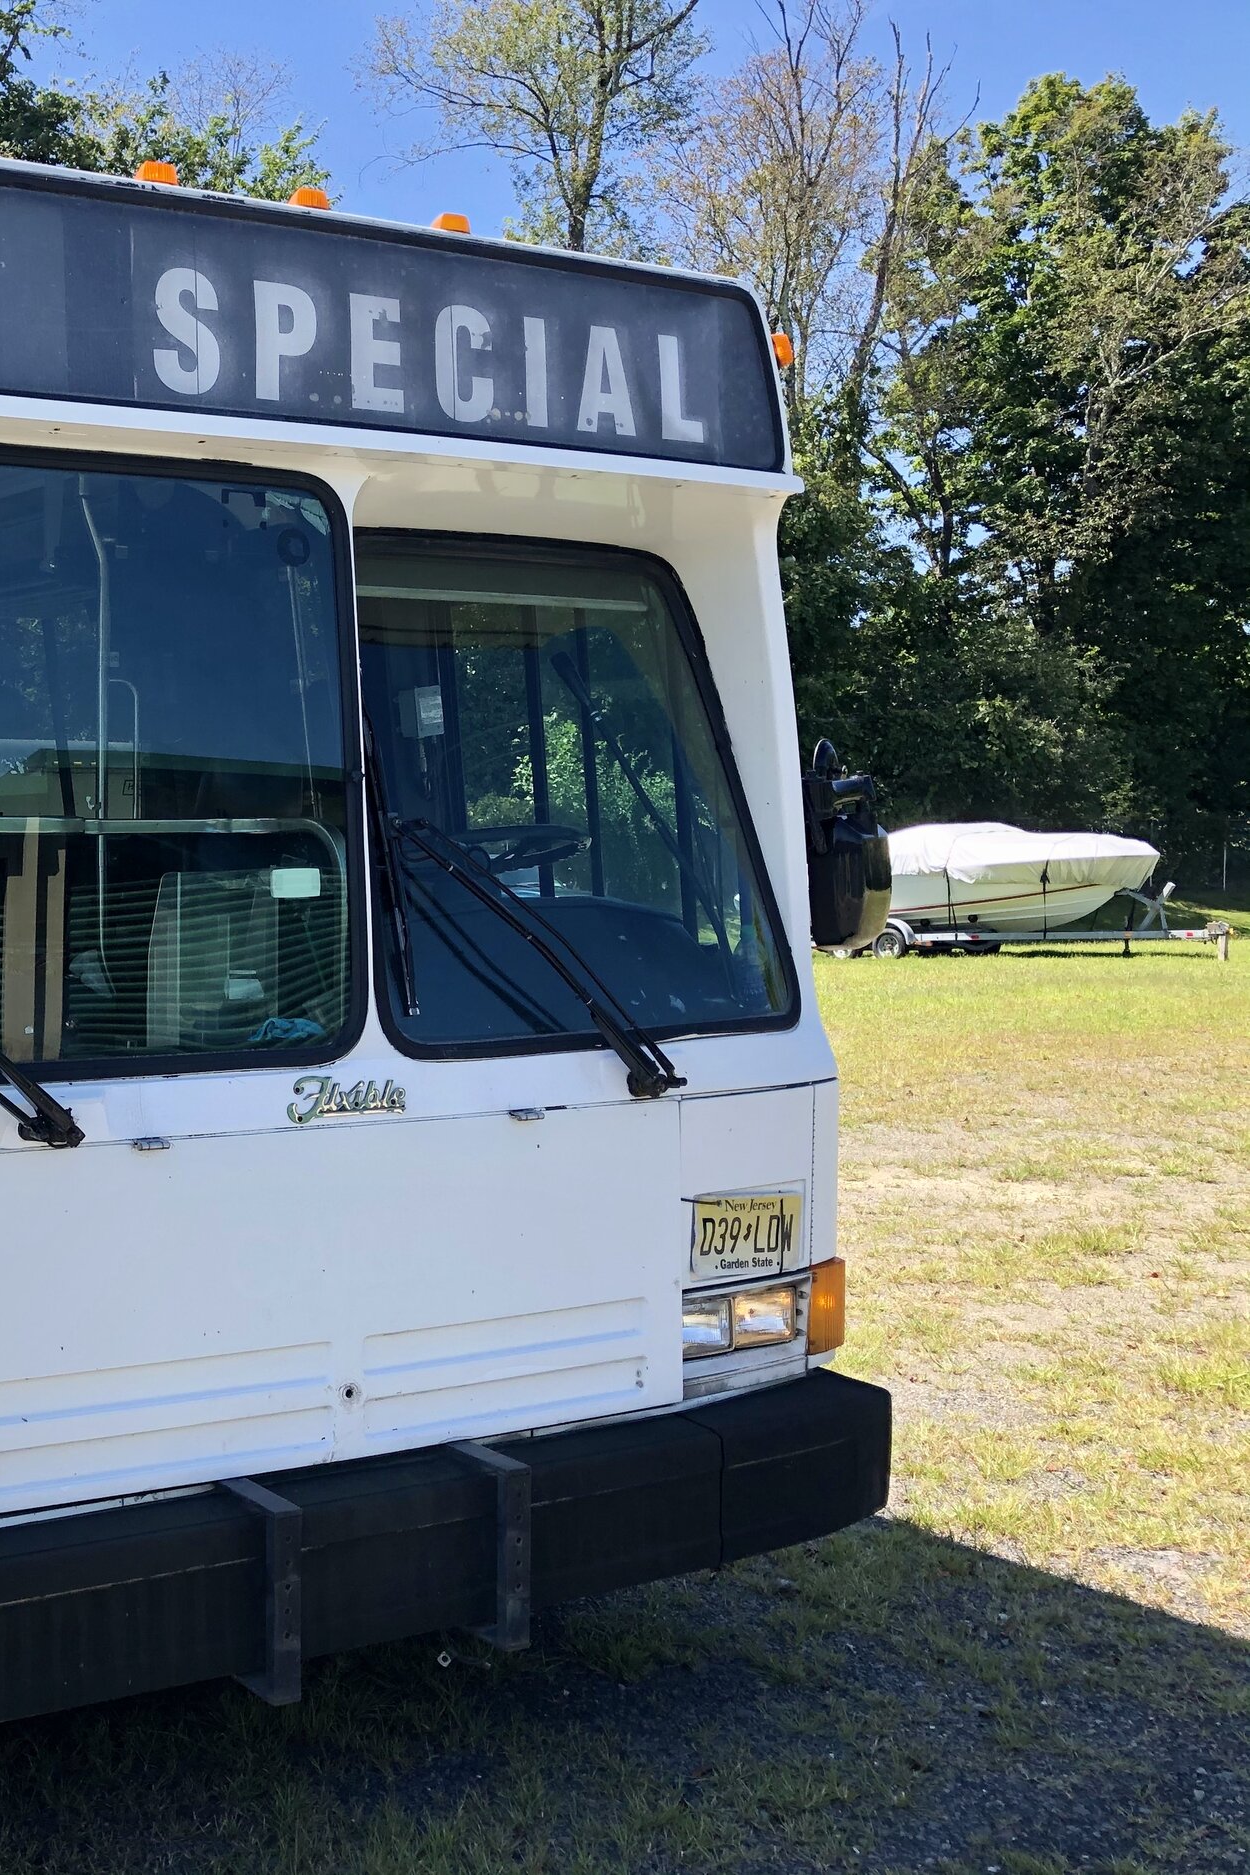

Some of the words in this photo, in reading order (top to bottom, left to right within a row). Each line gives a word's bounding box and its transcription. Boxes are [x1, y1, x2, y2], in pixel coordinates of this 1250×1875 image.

[153, 267, 704, 443] SPECIAL
[725, 1199, 748, 1212] New
[748, 1199, 777, 1213] Jersey
[720, 1258, 750, 1269] Garden
[752, 1257, 773, 1267] State
